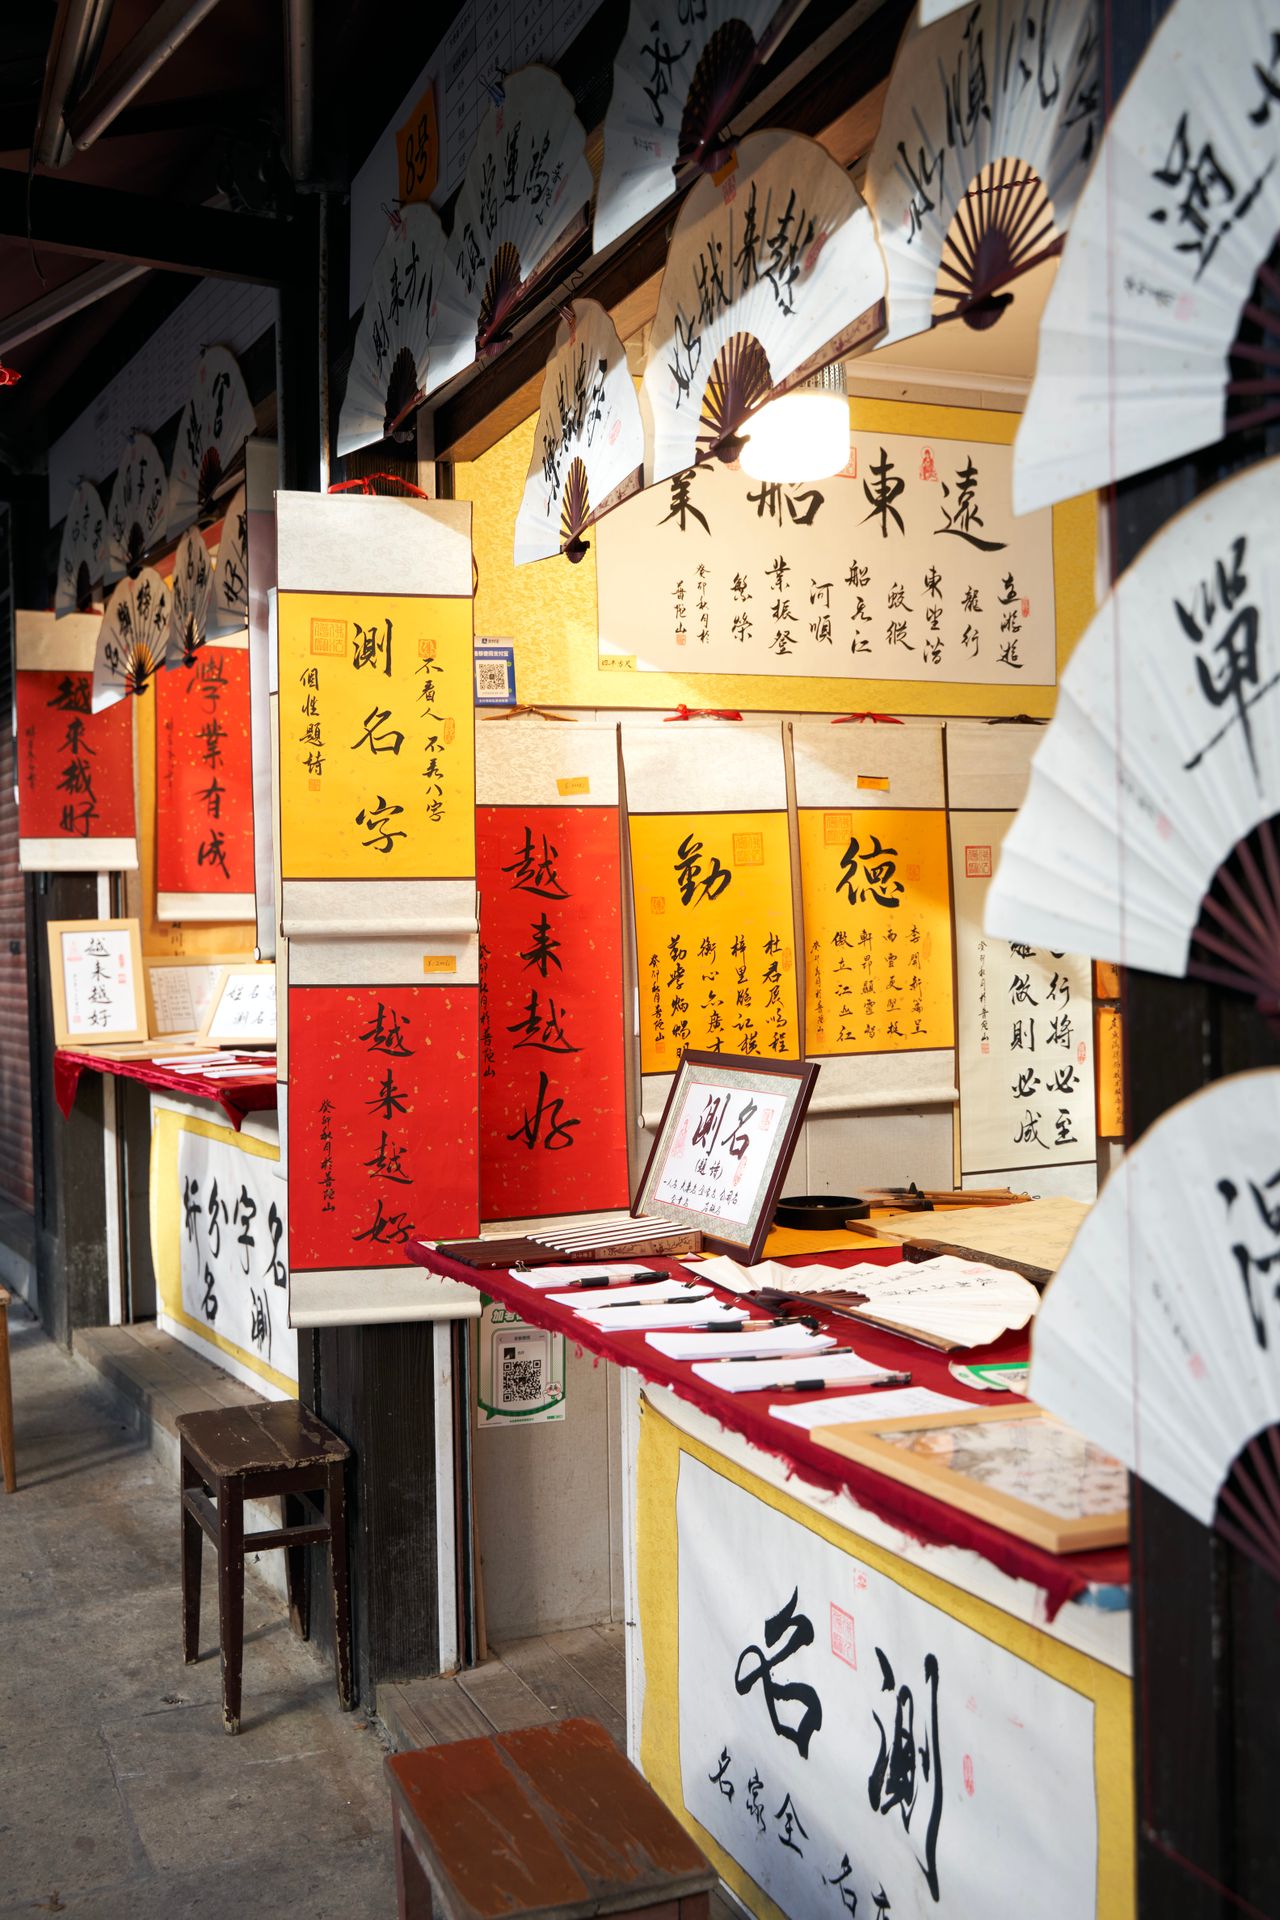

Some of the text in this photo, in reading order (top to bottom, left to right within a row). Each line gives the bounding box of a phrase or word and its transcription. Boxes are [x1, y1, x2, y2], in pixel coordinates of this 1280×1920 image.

[351, 618, 407, 854] 測名字
[1045, 949, 1081, 1146] 行將必至
